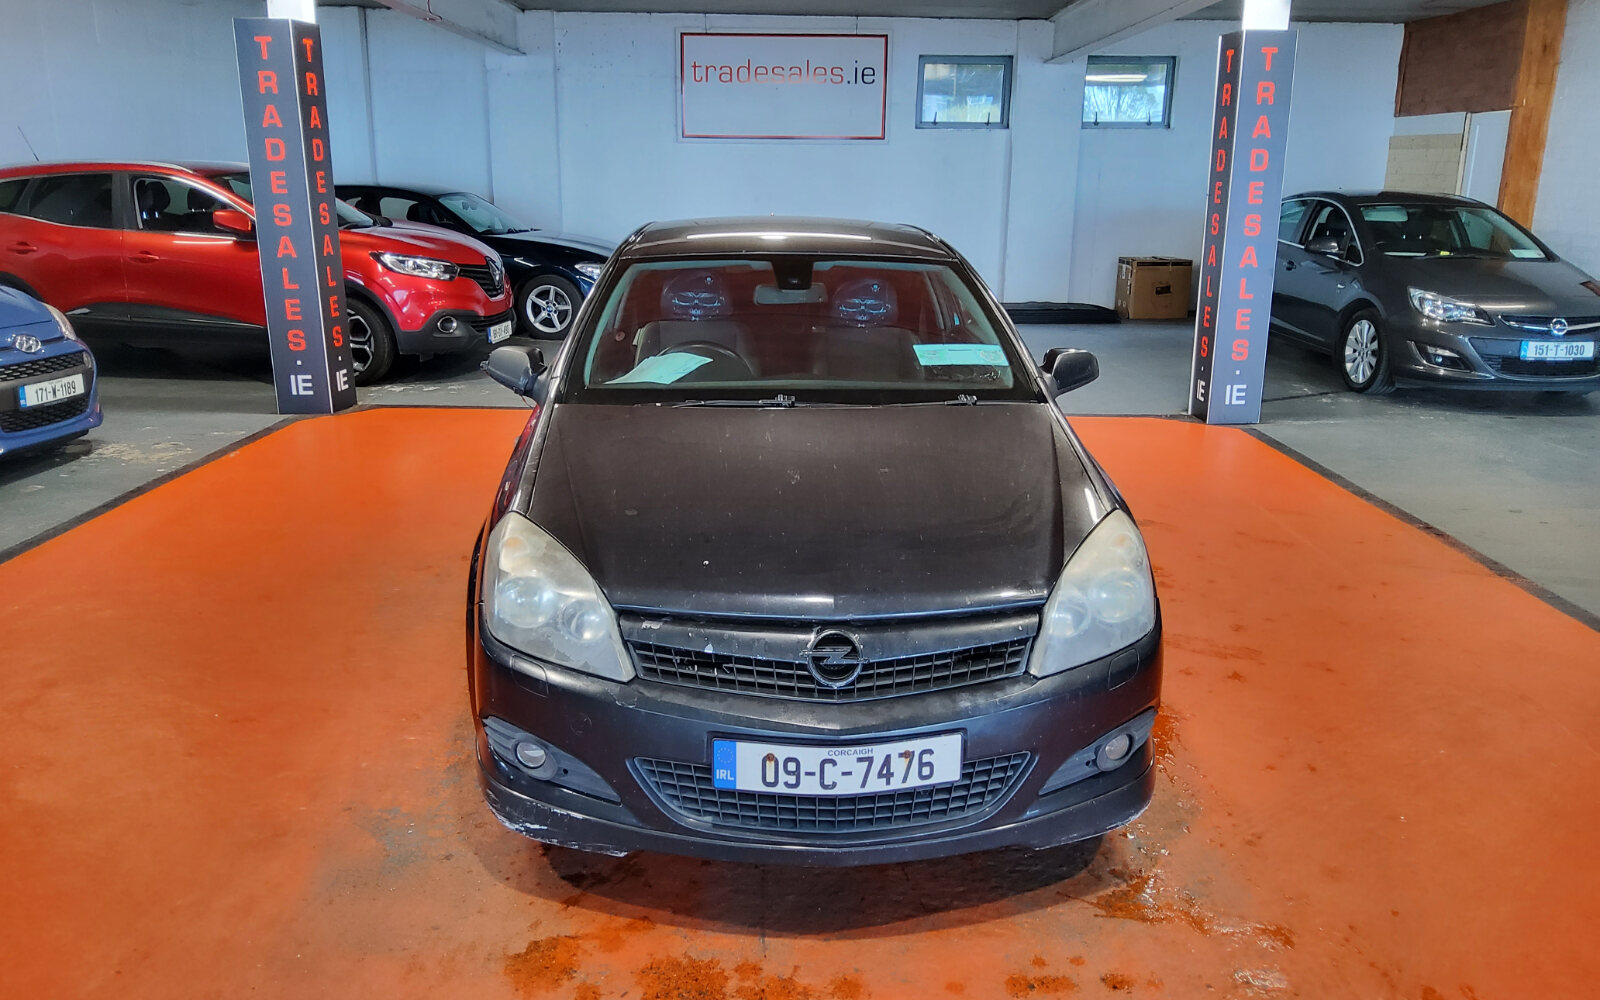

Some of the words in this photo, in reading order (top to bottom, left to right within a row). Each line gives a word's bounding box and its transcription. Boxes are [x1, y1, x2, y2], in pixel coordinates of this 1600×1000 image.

[691, 58, 876, 85] tradesales.ie
[1534, 344, 1585, 356] 151-T-1030
[35, 380, 77, 402] 171-W-1189
[827, 747, 874, 757] CORCAIGH
[716, 769, 735, 781] IRL
[761, 748, 935, 790] 09-C-7476
